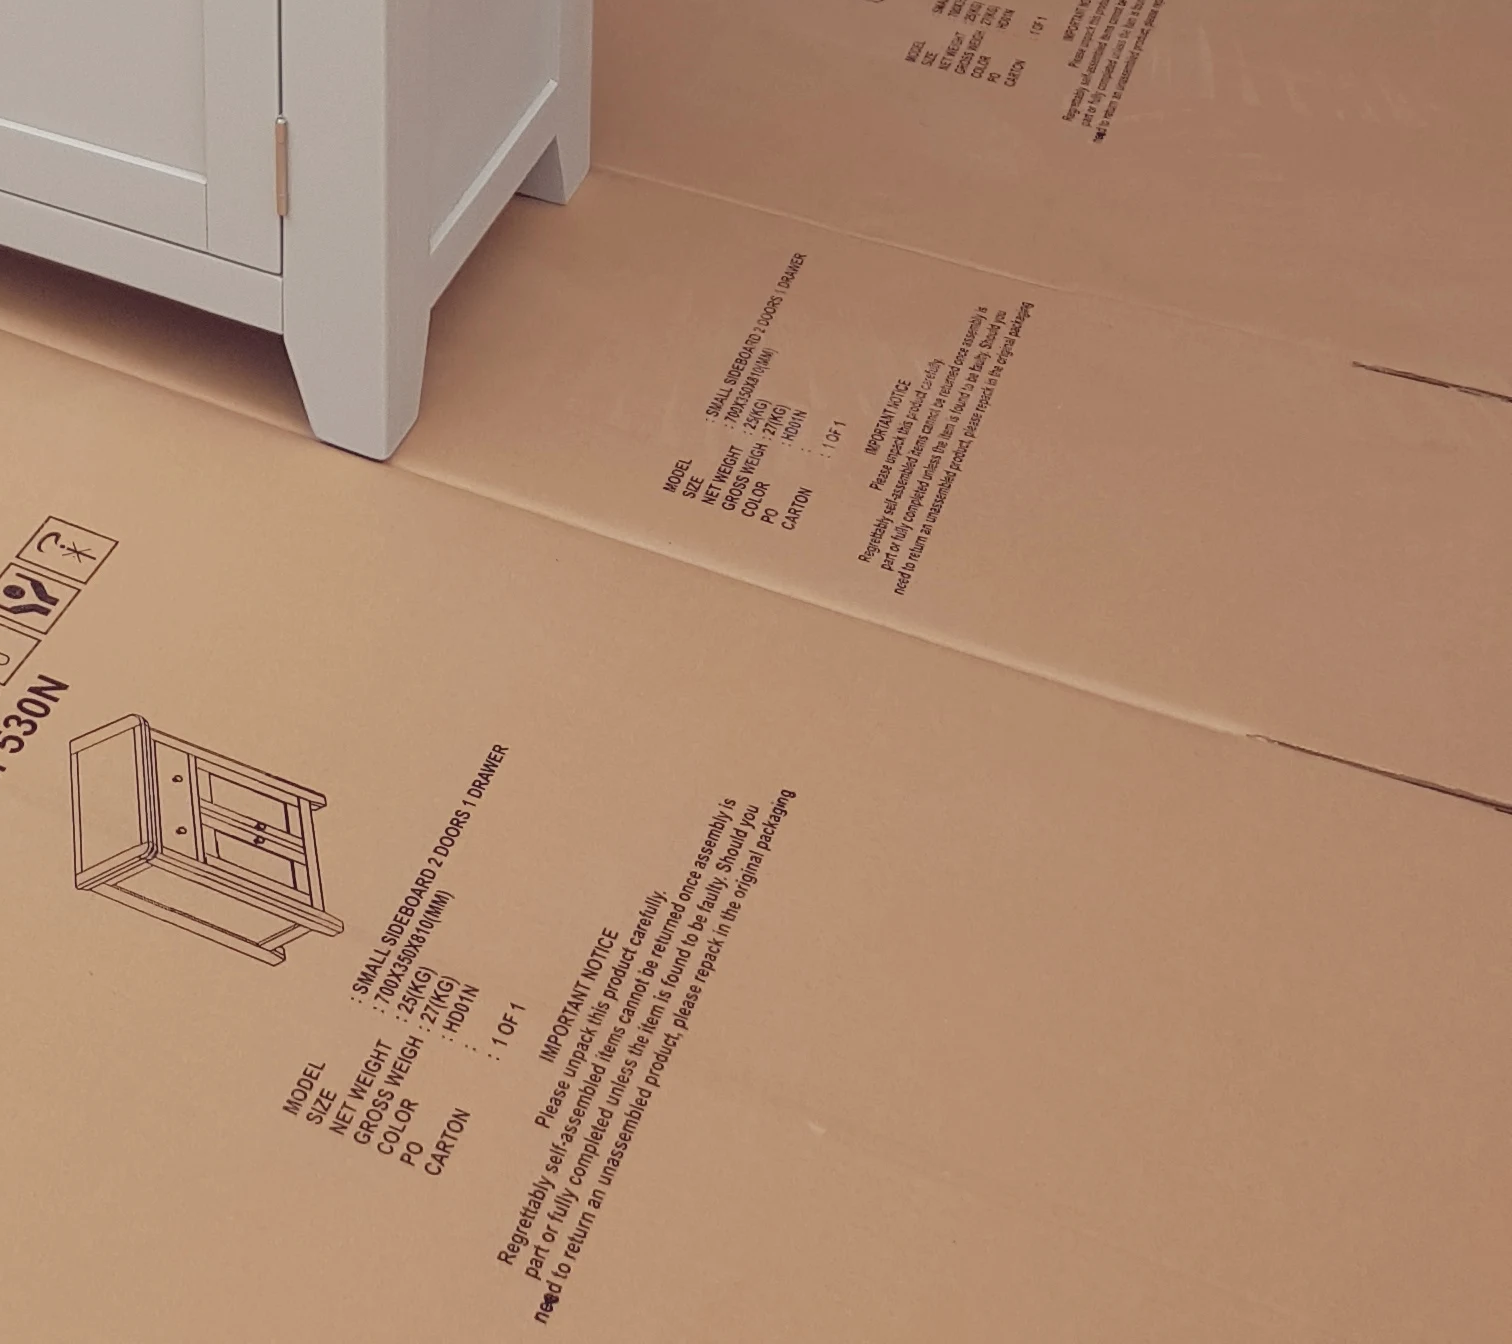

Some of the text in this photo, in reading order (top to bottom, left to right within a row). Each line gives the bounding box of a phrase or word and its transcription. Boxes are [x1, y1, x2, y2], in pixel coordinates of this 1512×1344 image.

[777, 252, 808, 289] DRAWER
[752, 326, 766, 334] 2
[755, 295, 783, 327] DOORS
[723, 334, 761, 385] SIDEBOARD
[705, 386, 733, 416] SMALL
[662, 459, 692, 493] MODEL
[701, 397, 773, 505] NET WEIGHT 25(KG)
[721, 403, 792, 510] GROSS WEIGH 27(KG)
[741, 408, 807, 517] COLOR HD01N
[681, 475, 704, 498] SIZE
[780, 486, 812, 529] CARTON
[825, 427, 841, 442] OF
[760, 508, 778, 524] PO
[466, 744, 509, 799] DRAWER
[432, 809, 470, 857] DOORS
[756, 789, 796, 851] packaging
[427, 857, 443, 867] 2
[734, 849, 764, 898] original
[381, 868, 436, 946] SIDEBOARD
[712, 923, 731, 936] in
[720, 901, 741, 921] the
[352, 948, 391, 994] SMALL
[694, 937, 724, 983] repack
[306, 889, 455, 1124] SIZE 700X350X810(MM)
[534, 890, 667, 1128] Please unpack this product carefully.
[538, 926, 619, 1063] IMPORTANT NOTICE
[673, 984, 702, 1030] please
[328, 966, 438, 1135] NET WEIGHT 25(KG)
[496, 797, 736, 1265] Regrettably self-assembled items cannot be returned once assembly is
[525, 804, 759, 1280] part or fully completed unless the item is found to be faulty. Should you
[353, 975, 460, 1144] GROSS WEIGH 27(KG)
[377, 983, 479, 1154] COLOR HD01N
[644, 1032, 683, 1087] product,
[282, 1062, 326, 1115] MODEL
[424, 1001, 526, 1175] CARTON 1 OF 1
[399, 1141, 423, 1166] PO
[598, 1086, 652, 1185] unassembled
[587, 1188, 606, 1209] an
[564, 1211, 596, 1260] return
[551, 1262, 571, 1279] to
